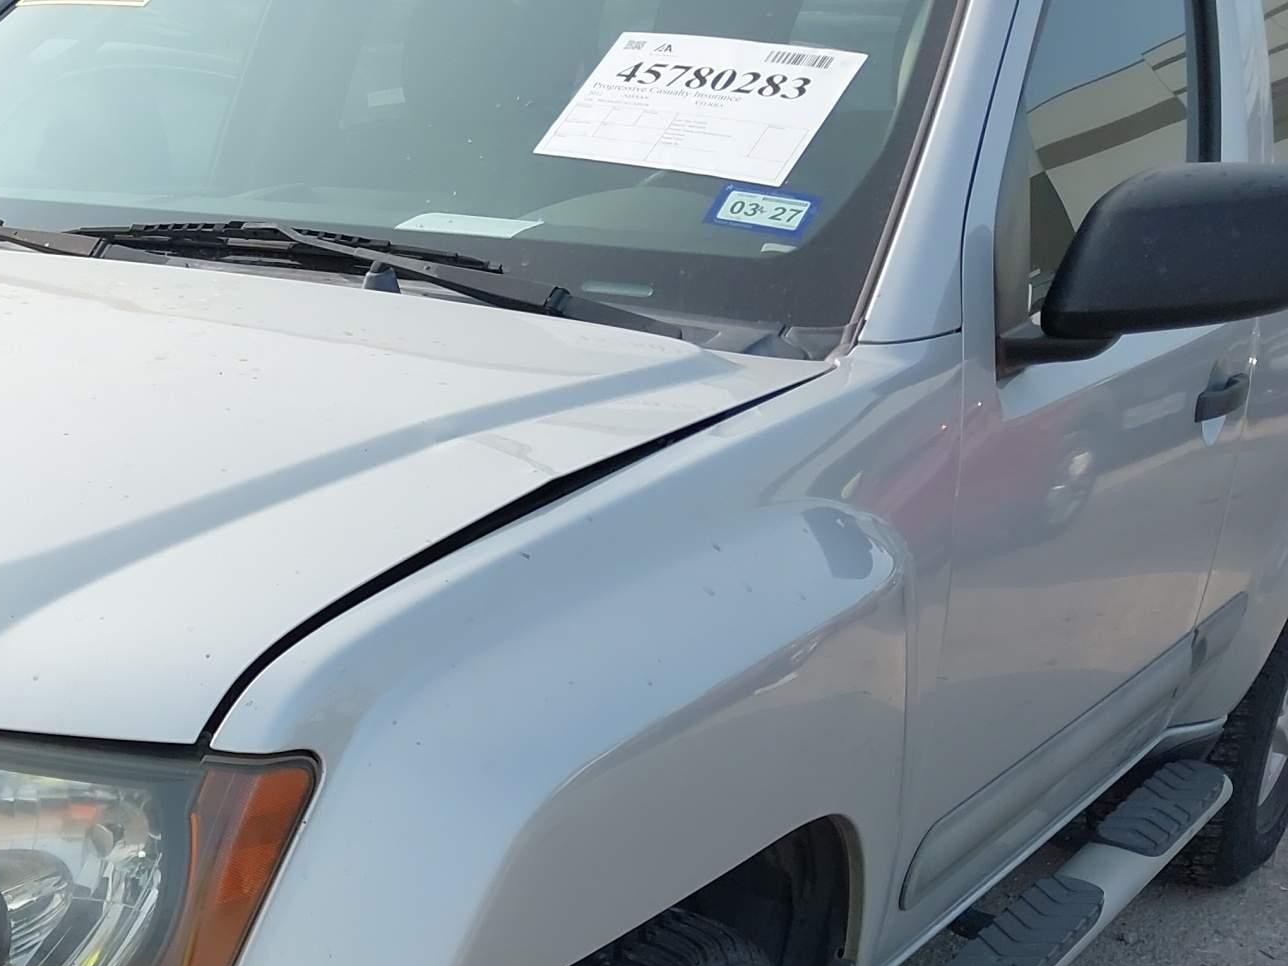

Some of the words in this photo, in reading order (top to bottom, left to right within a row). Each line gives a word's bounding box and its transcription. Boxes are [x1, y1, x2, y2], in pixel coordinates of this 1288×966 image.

[593, 81, 648, 93] Progressive
[649, 86, 690, 98] Casualty
[693, 90, 743, 102] Insurance
[616, 61, 812, 100] 45780283
[729, 200, 760, 217] 03
[768, 206, 804, 223] 27
